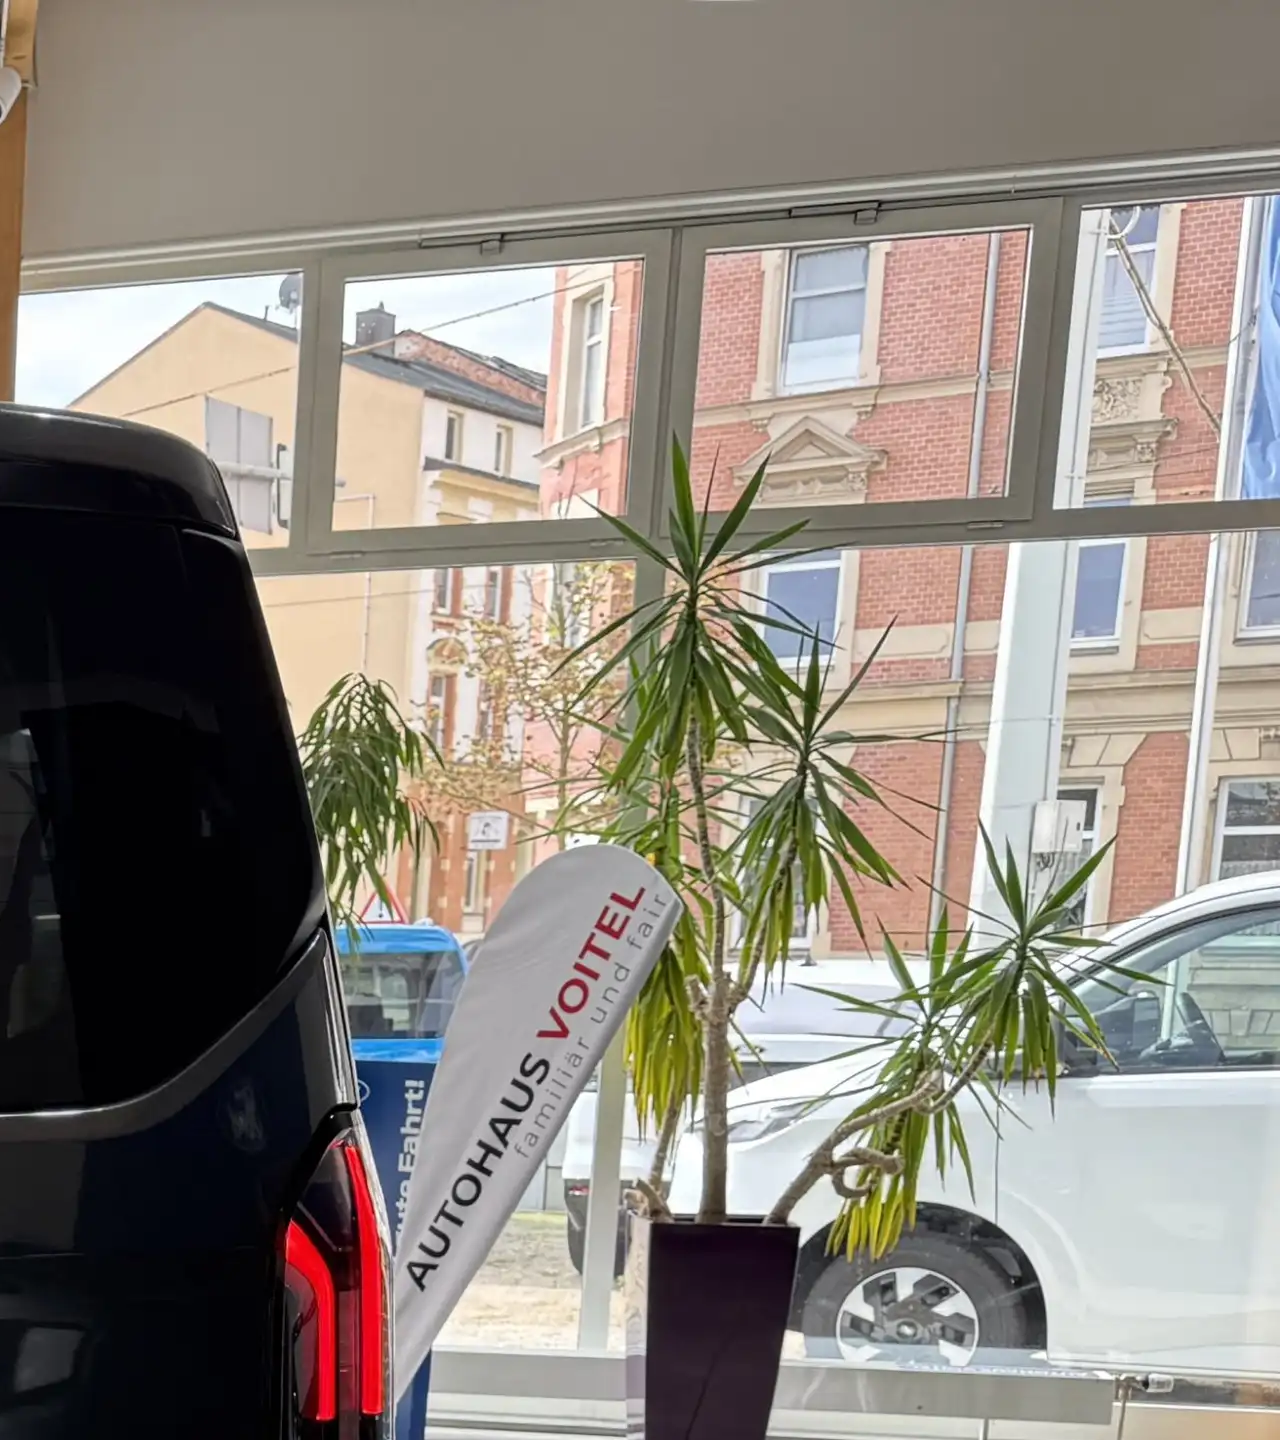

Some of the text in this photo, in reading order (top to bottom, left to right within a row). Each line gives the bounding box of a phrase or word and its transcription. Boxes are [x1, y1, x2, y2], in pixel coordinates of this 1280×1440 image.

[406, 886, 646, 1292] AUTOHAUS VOITEL
[515, 893, 668, 1159] familiär und fair
